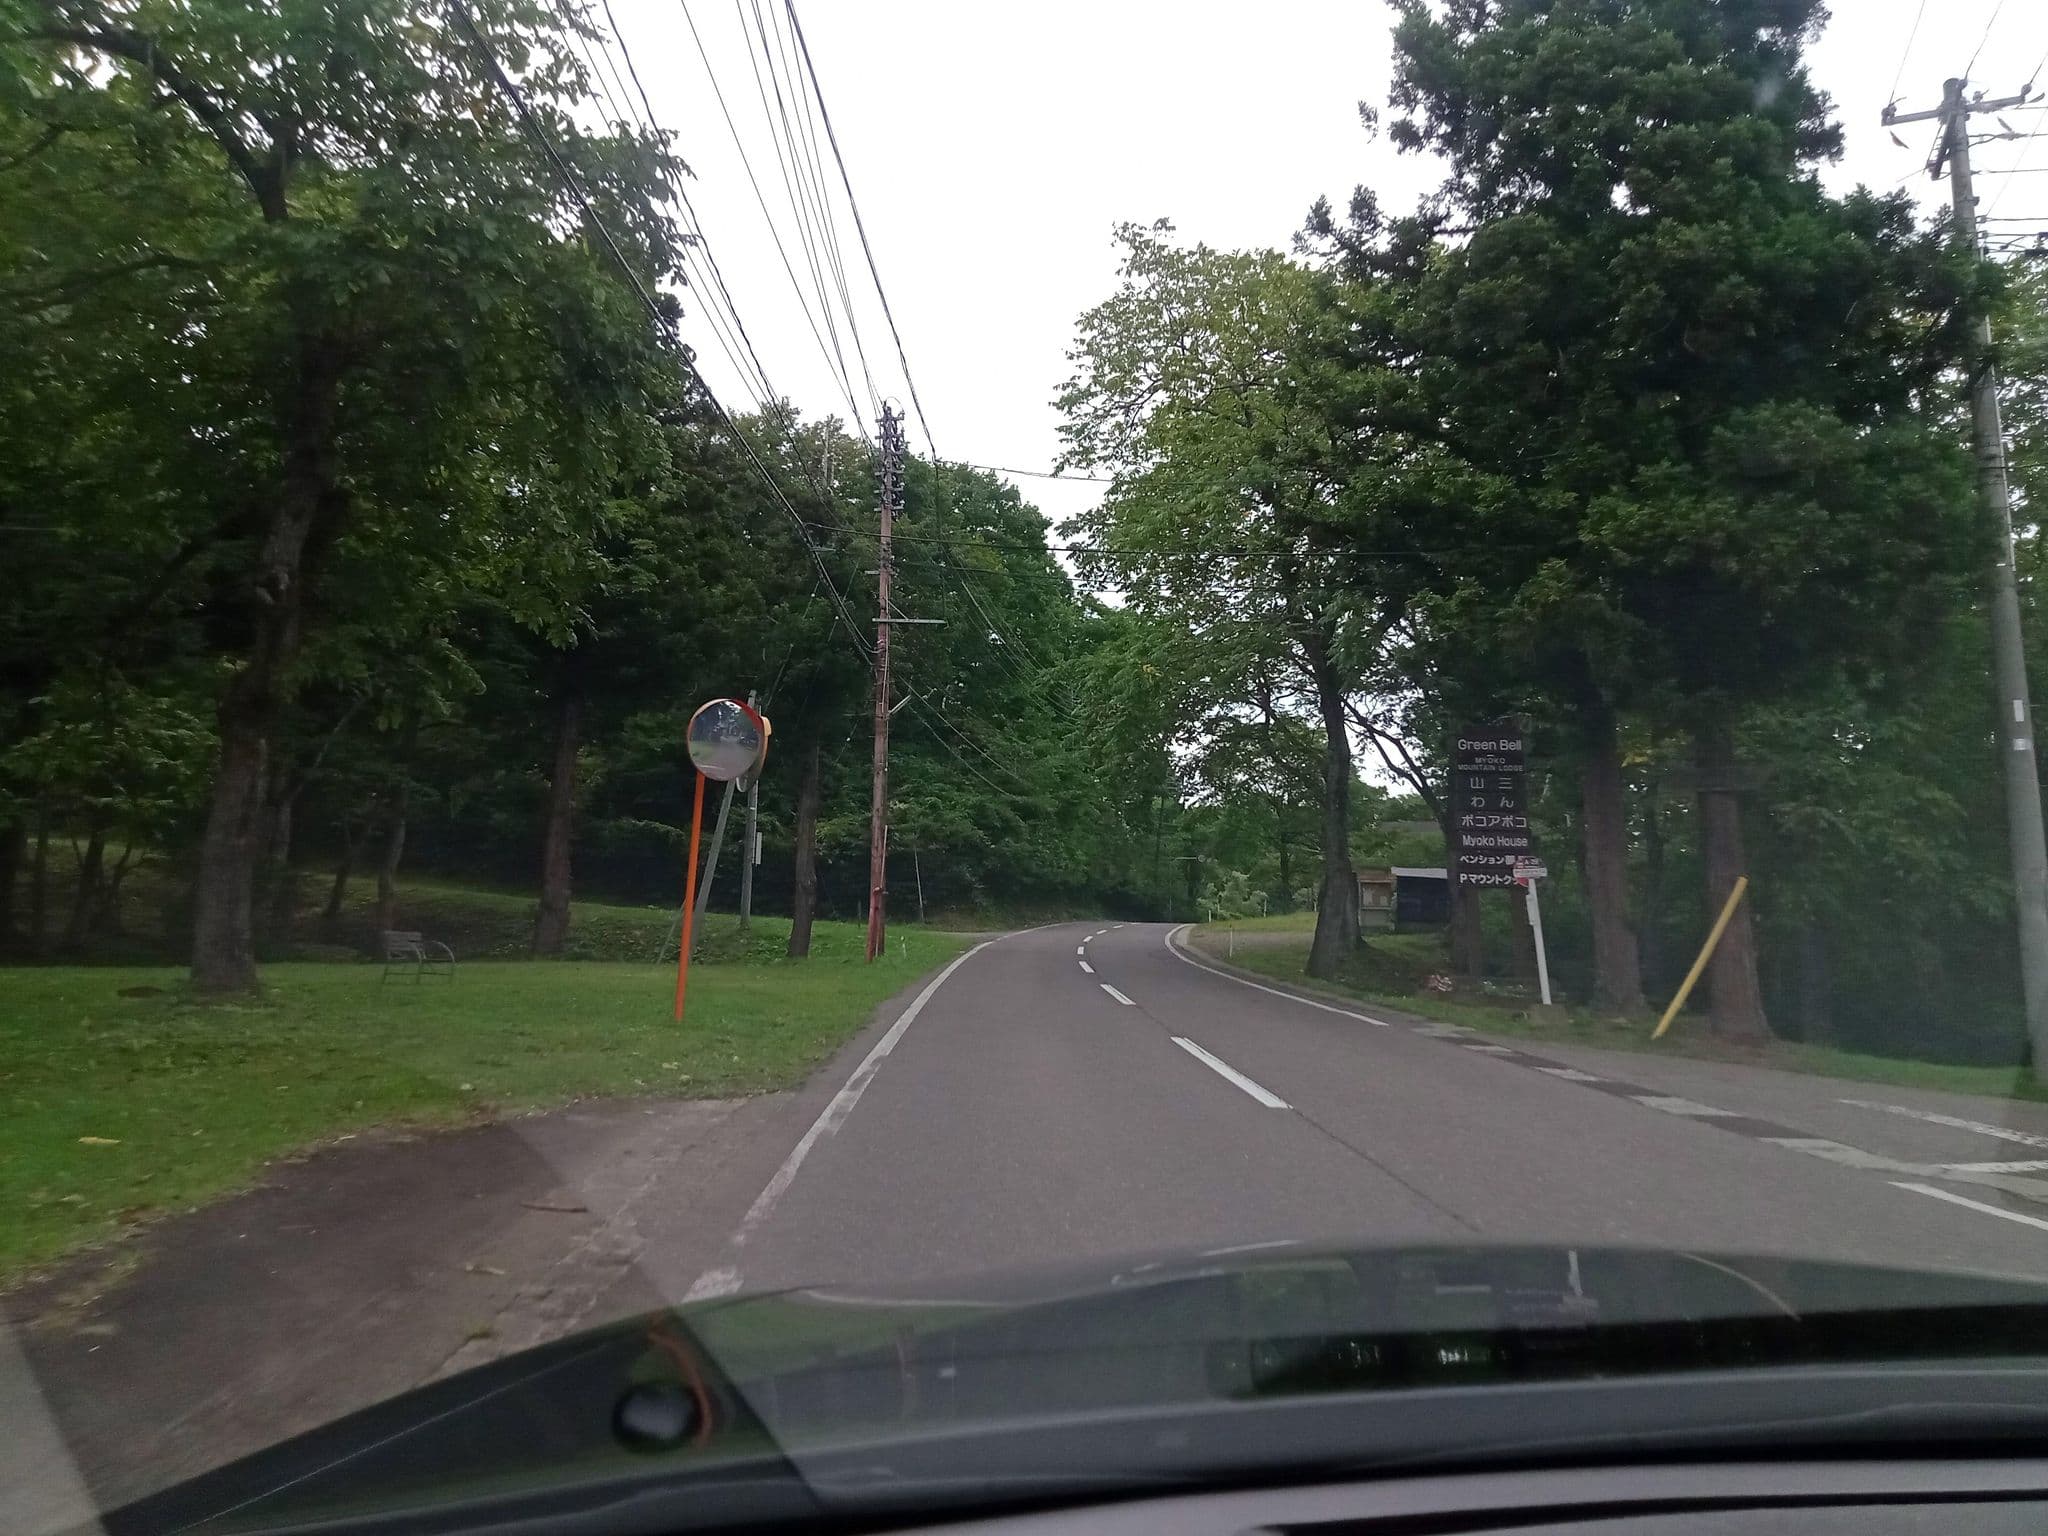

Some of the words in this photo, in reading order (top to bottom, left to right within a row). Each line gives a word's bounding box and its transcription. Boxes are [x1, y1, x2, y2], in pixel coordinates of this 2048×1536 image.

[1458, 739, 1497, 750] Green
[1500, 739, 1522, 750] Bell
[1463, 835, 1495, 848] Myoko
[1497, 836, 1529, 848] House
